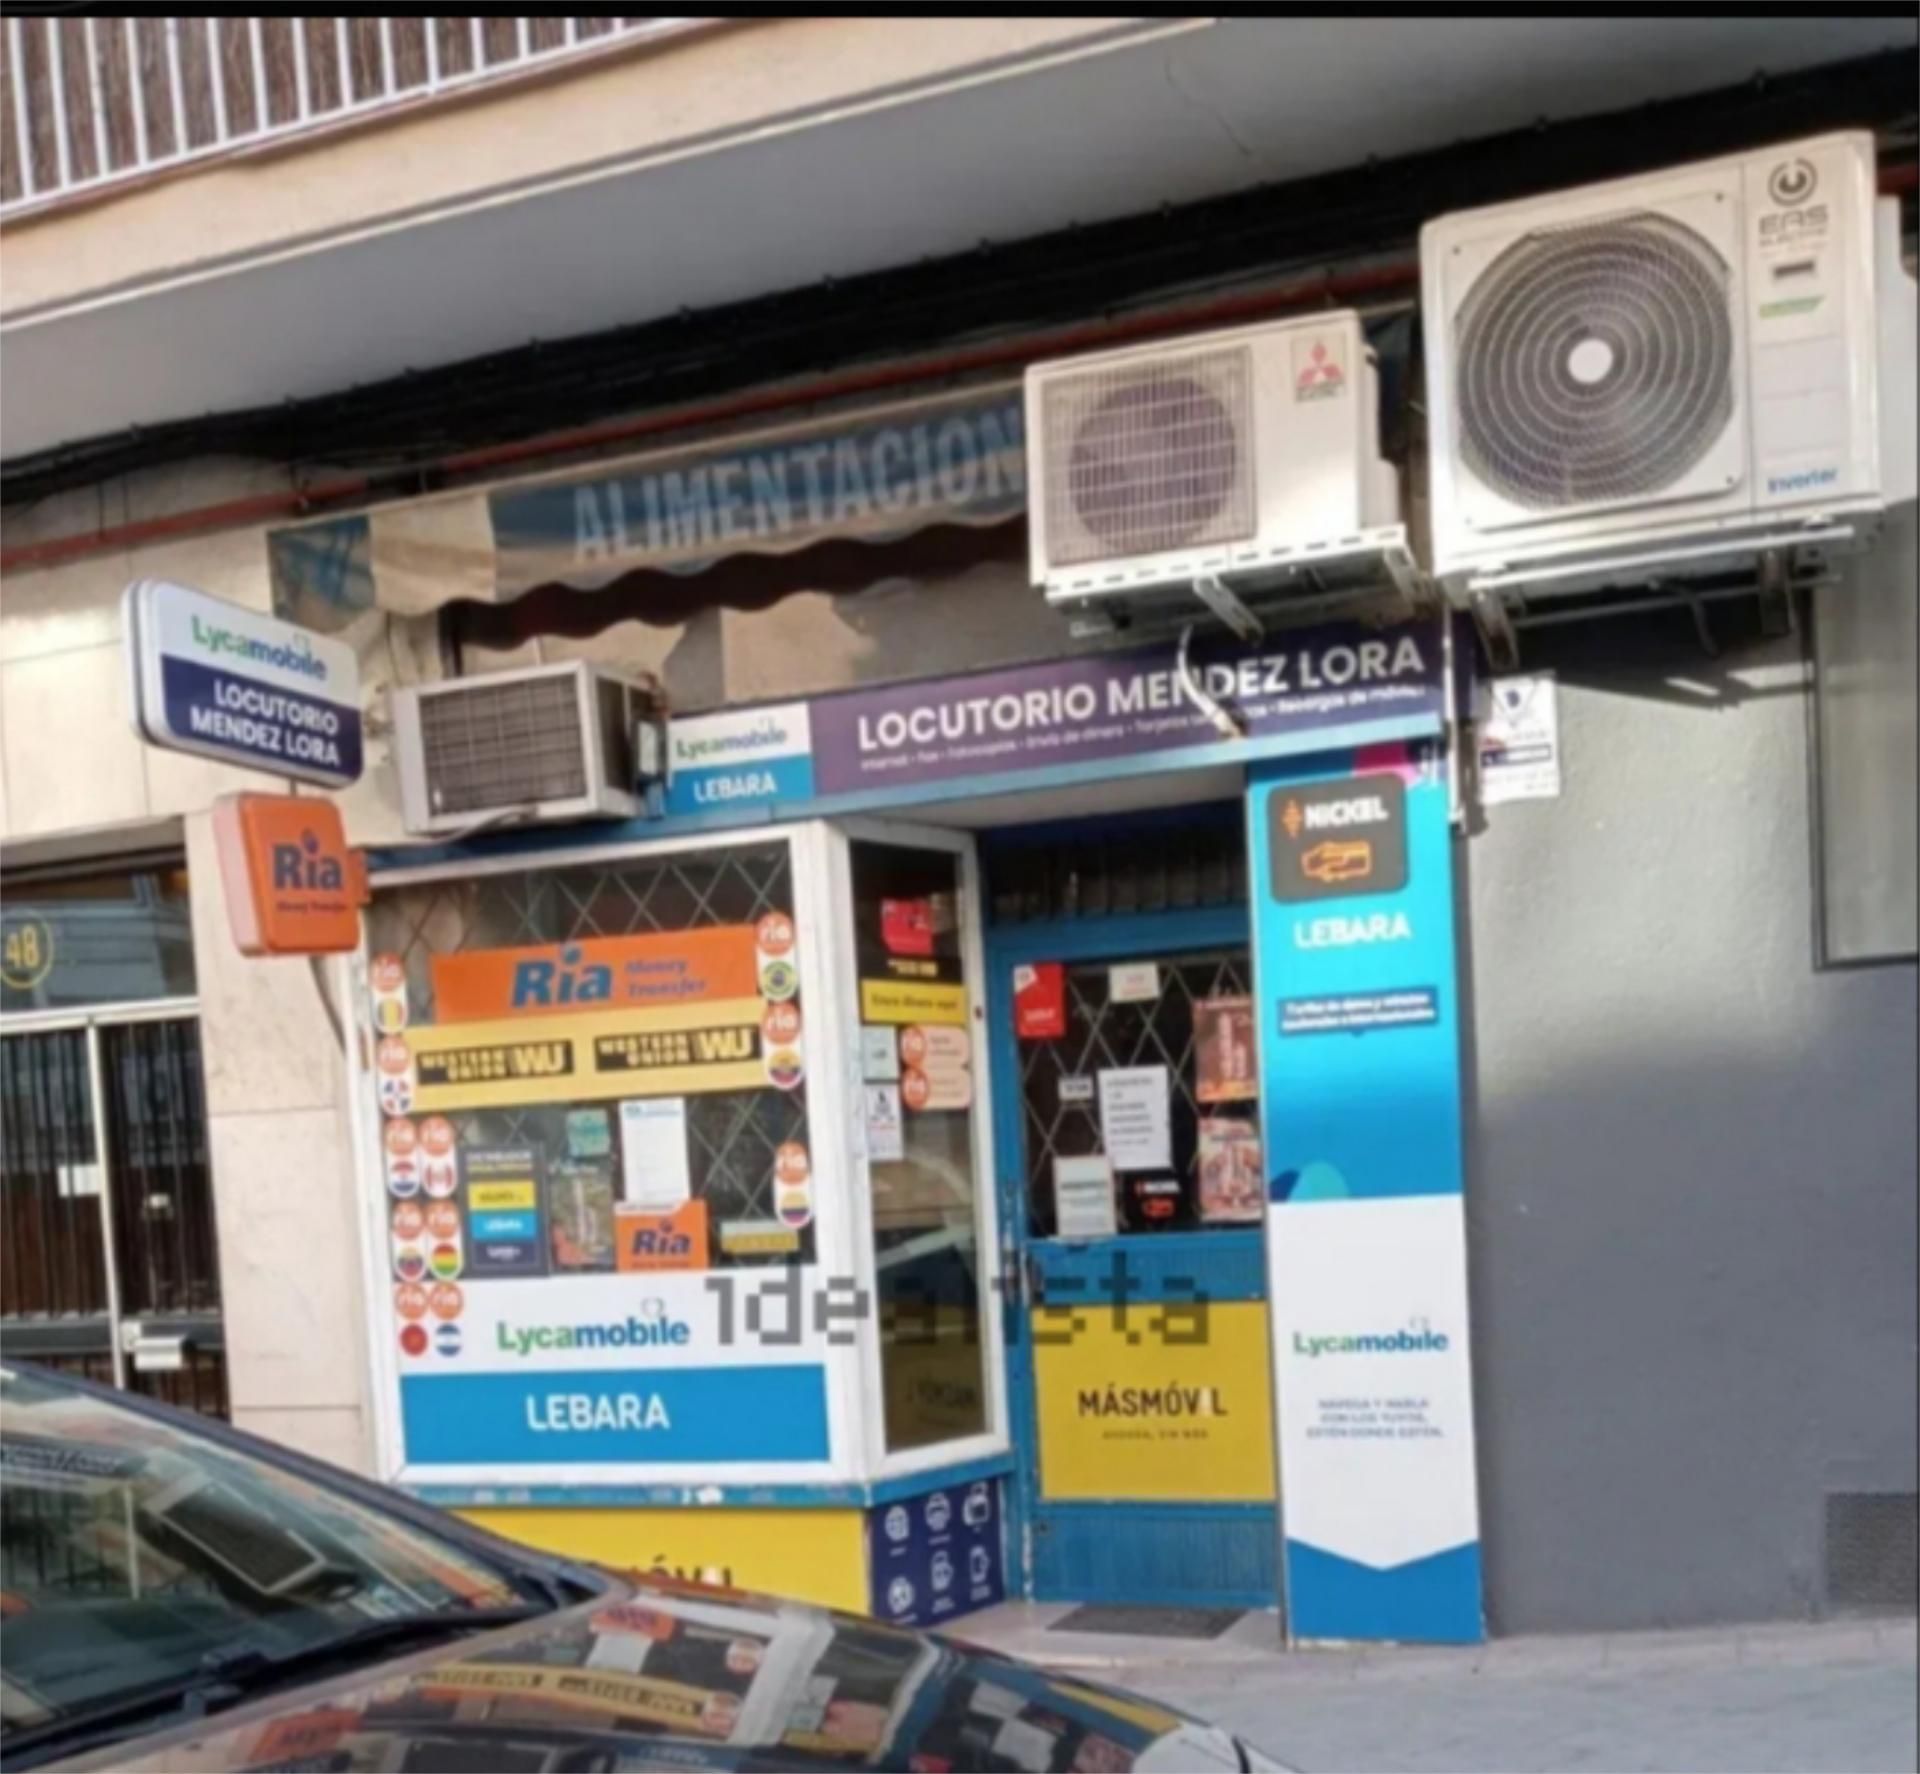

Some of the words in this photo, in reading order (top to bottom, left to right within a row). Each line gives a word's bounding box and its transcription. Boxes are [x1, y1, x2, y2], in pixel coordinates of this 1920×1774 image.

[572, 406, 1023, 563] ALIMENTACION
[191, 615, 327, 680] Lycamobile
[213, 679, 338, 735] LOCUTORIO
[858, 683, 1096, 751] LOCUTORIO
[1107, 654, 1289, 715] MENDEZ
[1300, 637, 1425, 687] LORA
[190, 706, 281, 754] MENDEZ
[285, 732, 341, 767] LORA
[675, 723, 788, 761] Lycamobile
[694, 772, 778, 803] LEBARA
[273, 829, 342, 892] Ria
[6, 925, 39, 968] 48
[1293, 912, 1412, 949] LEBARA
[512, 943, 612, 1007] Ria
[513, 1043, 564, 1074] WU
[698, 1027, 750, 1060] WU
[632, 1219, 691, 1256] Ria
[497, 1315, 690, 1357] Lycamobile
[1293, 1330, 1448, 1358] Lycamobile
[526, 1393, 670, 1431] LEBARA
